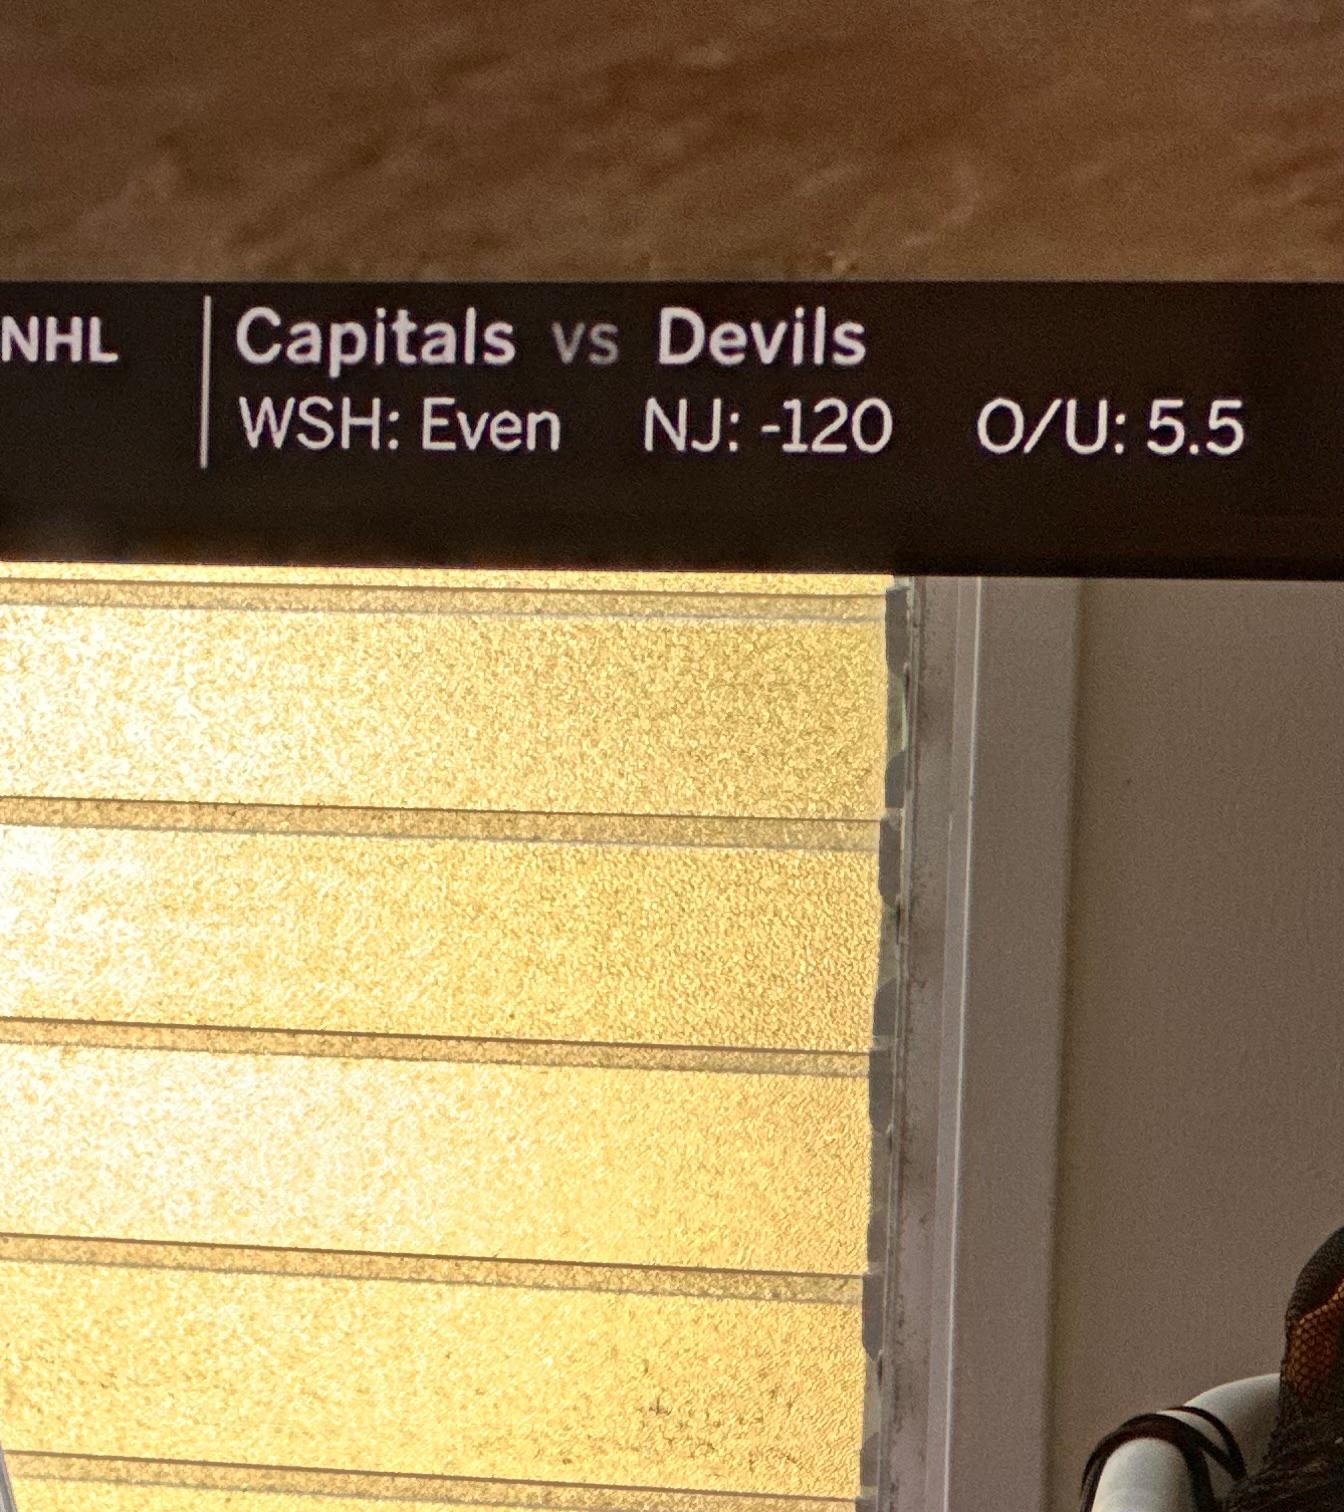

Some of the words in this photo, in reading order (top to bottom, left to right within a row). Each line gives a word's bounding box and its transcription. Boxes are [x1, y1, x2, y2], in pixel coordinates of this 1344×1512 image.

[1, 315, 119, 364] NHL
[236, 306, 516, 379] Capitals
[552, 321, 619, 365] vs
[658, 305, 867, 366] Devils
[238, 395, 400, 451] WSH:
[421, 396, 561, 452] Even
[644, 396, 740, 453] NJ:
[760, 397, 893, 454] -120
[977, 396, 1126, 455] O/U:
[1146, 398, 1245, 456] 5.5
